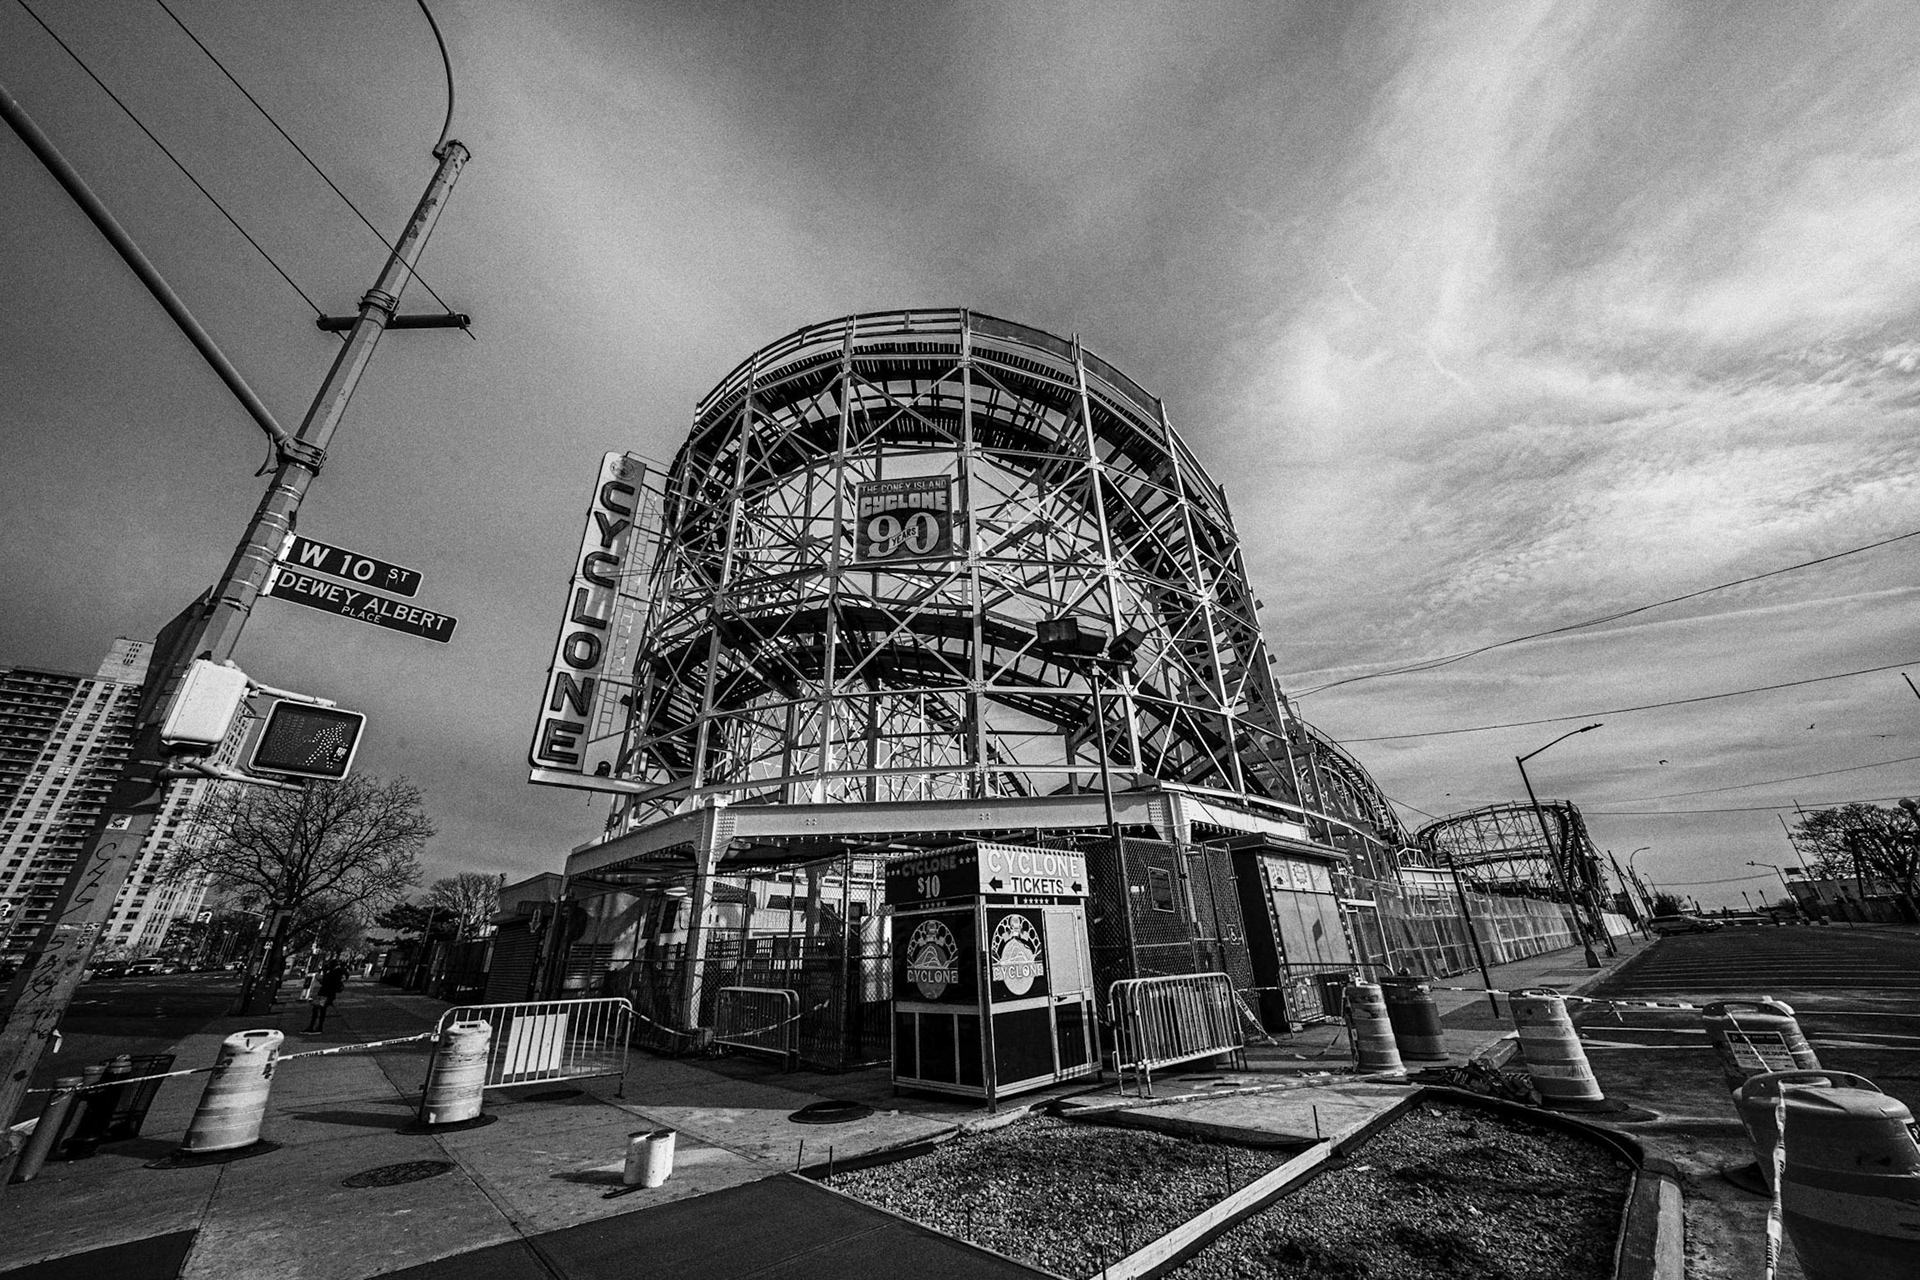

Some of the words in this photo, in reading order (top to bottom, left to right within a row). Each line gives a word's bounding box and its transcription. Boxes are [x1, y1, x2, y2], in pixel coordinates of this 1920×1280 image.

[862, 485, 878, 494] THE
[881, 482, 911, 494] CONEY
[914, 480, 947, 490] ISLAND
[860, 491, 948, 518] CYCLONE
[867, 512, 940, 558] 90
[891, 527, 917, 546] YEARS
[300, 542, 330, 567] W
[339, 555, 376, 581] 10
[388, 568, 410, 582] ST
[278, 572, 360, 606] DEWEY
[363, 598, 448, 632] ALBERT
[341, 606, 382, 623] PLACE
[538, 480, 635, 765] CYCLONE
[902, 854, 957, 877] CYCLONE
[987, 848, 1081, 878] CYCLONE
[917, 875, 941, 899] $10
[1011, 876, 1064, 895] TICKETS
[907, 969, 958, 983] CYCLONE
[992, 963, 1044, 981] CYCLONE
